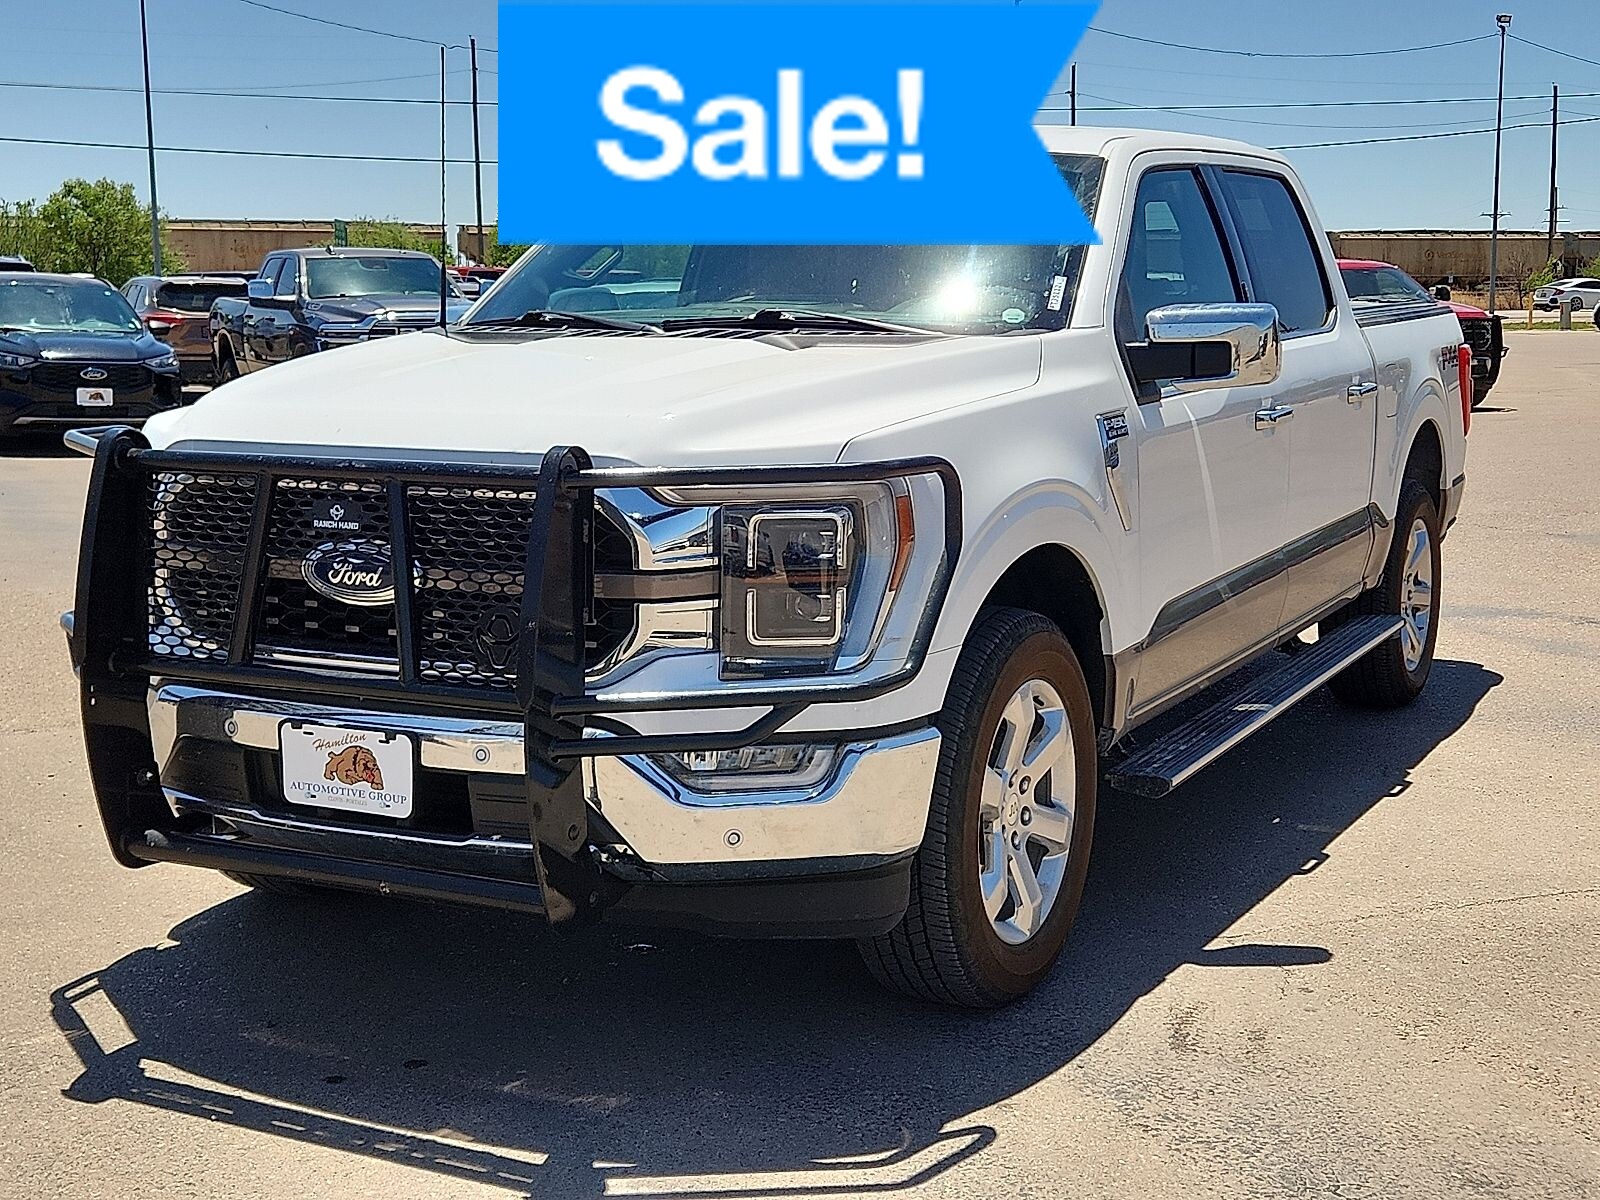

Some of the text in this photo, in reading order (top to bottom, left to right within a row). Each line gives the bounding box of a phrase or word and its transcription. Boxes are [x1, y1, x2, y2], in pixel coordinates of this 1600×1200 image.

[313, 519, 359, 530] RANCH HAND
[328, 562, 383, 587] Ford
[311, 732, 367, 752] Hamilton
[290, 781, 407, 805] AUTOMOTIVE GROUP
